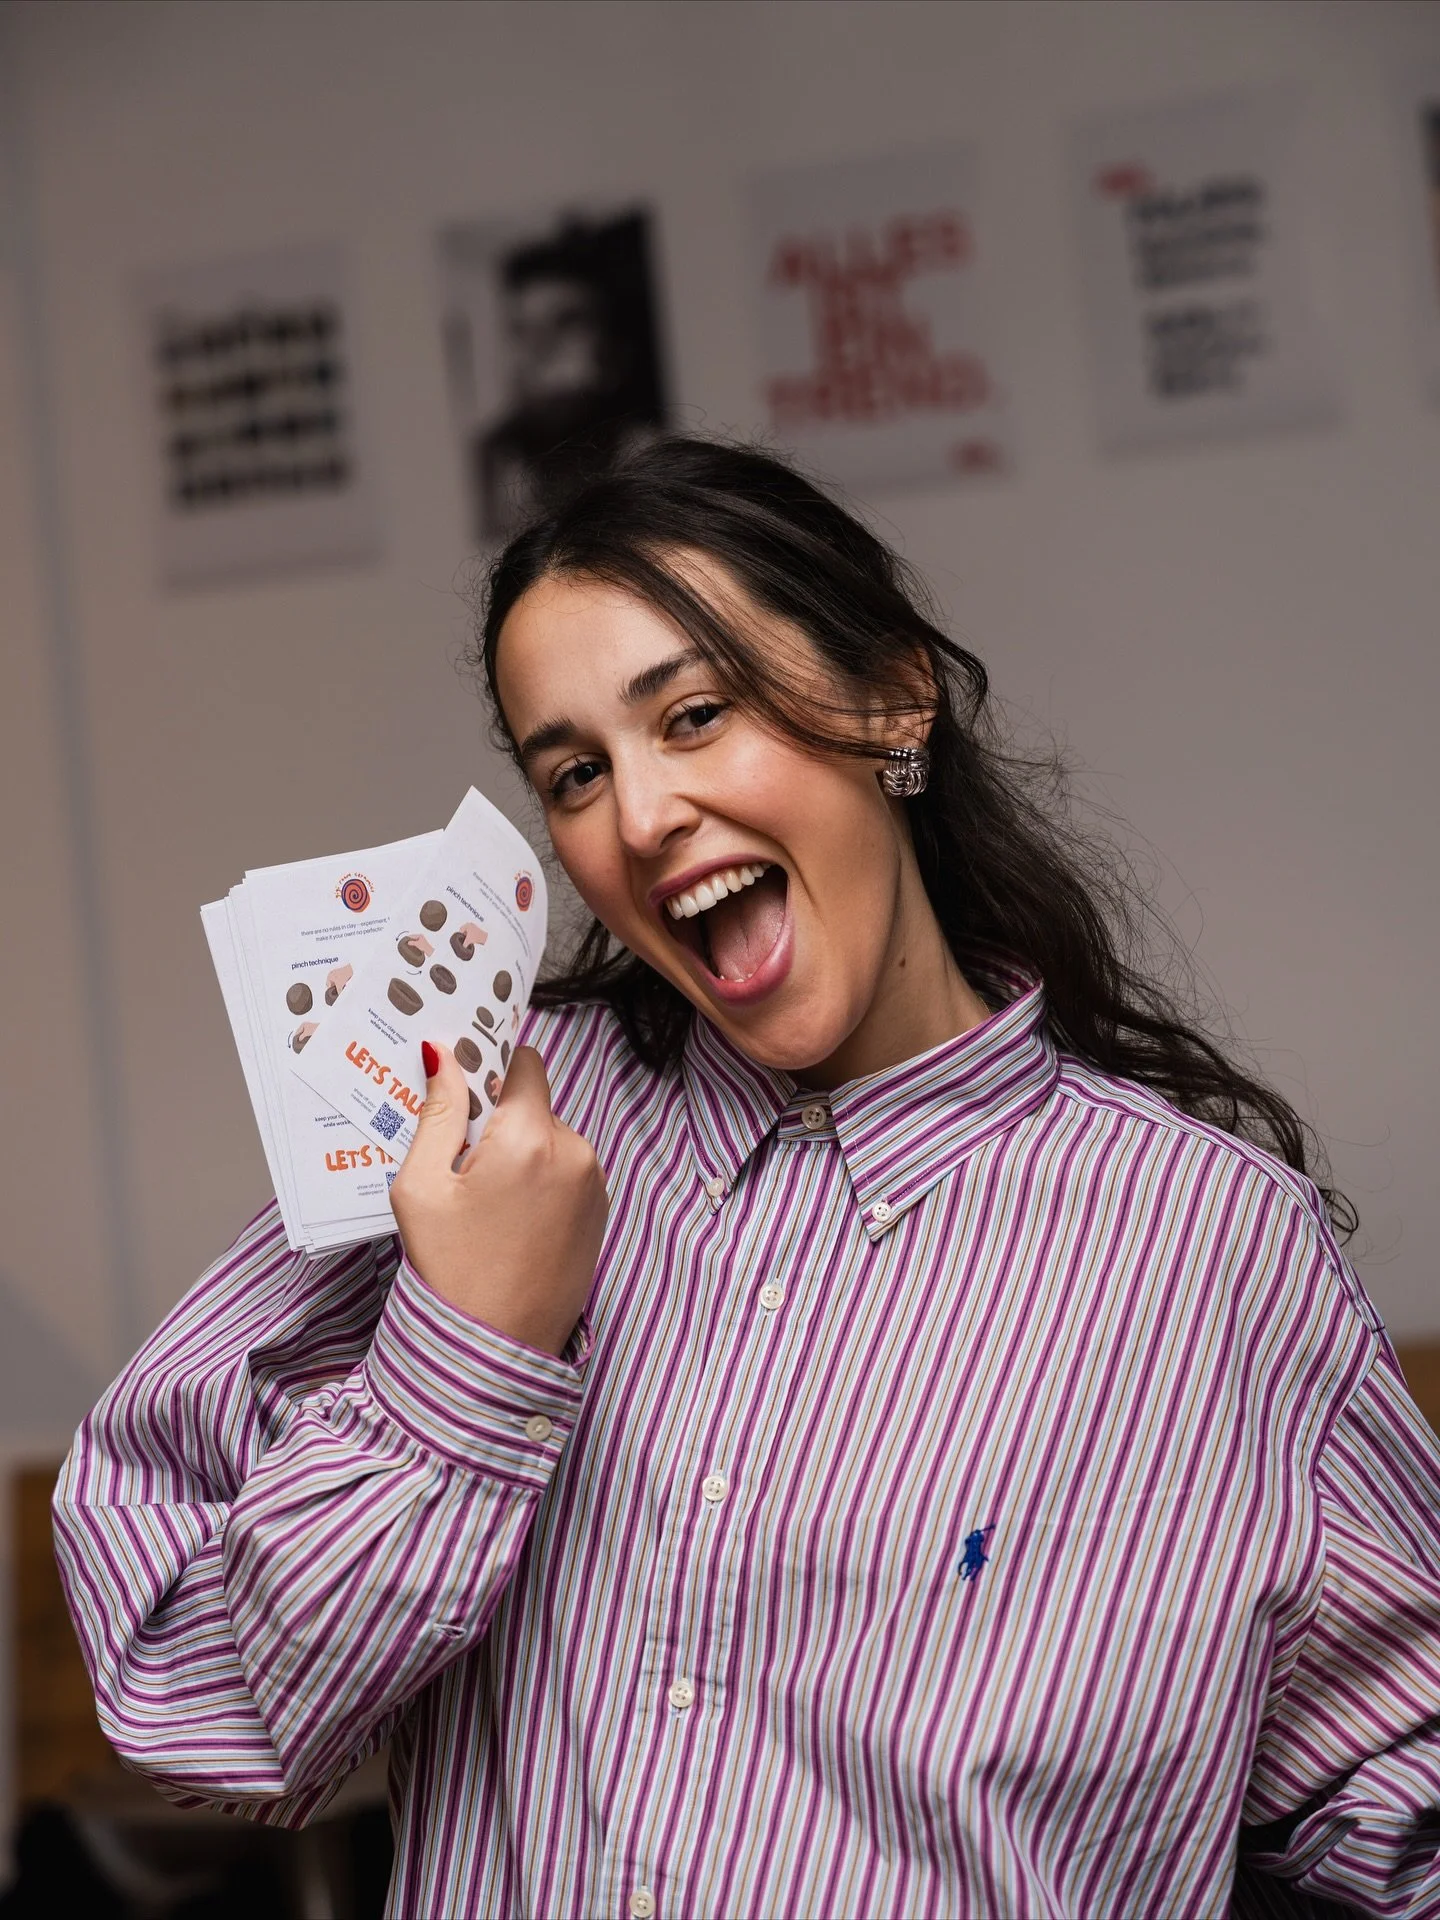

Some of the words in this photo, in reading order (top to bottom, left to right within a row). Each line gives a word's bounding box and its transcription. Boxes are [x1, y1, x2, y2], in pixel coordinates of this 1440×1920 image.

[446, 885, 461, 901] pinch
[460, 897, 485, 922] technique
[291, 961, 308, 970] pinch
[309, 956, 338, 966] technique
[368, 1008, 379, 1019] keep
[378, 1017, 388, 1027] your
[387, 1025, 396, 1034] clay
[395, 1032, 407, 1044] moist
[370, 1019, 381, 1030] while
[345, 1040, 391, 1085] LET'S
[325, 1145, 372, 1171] LET'S
